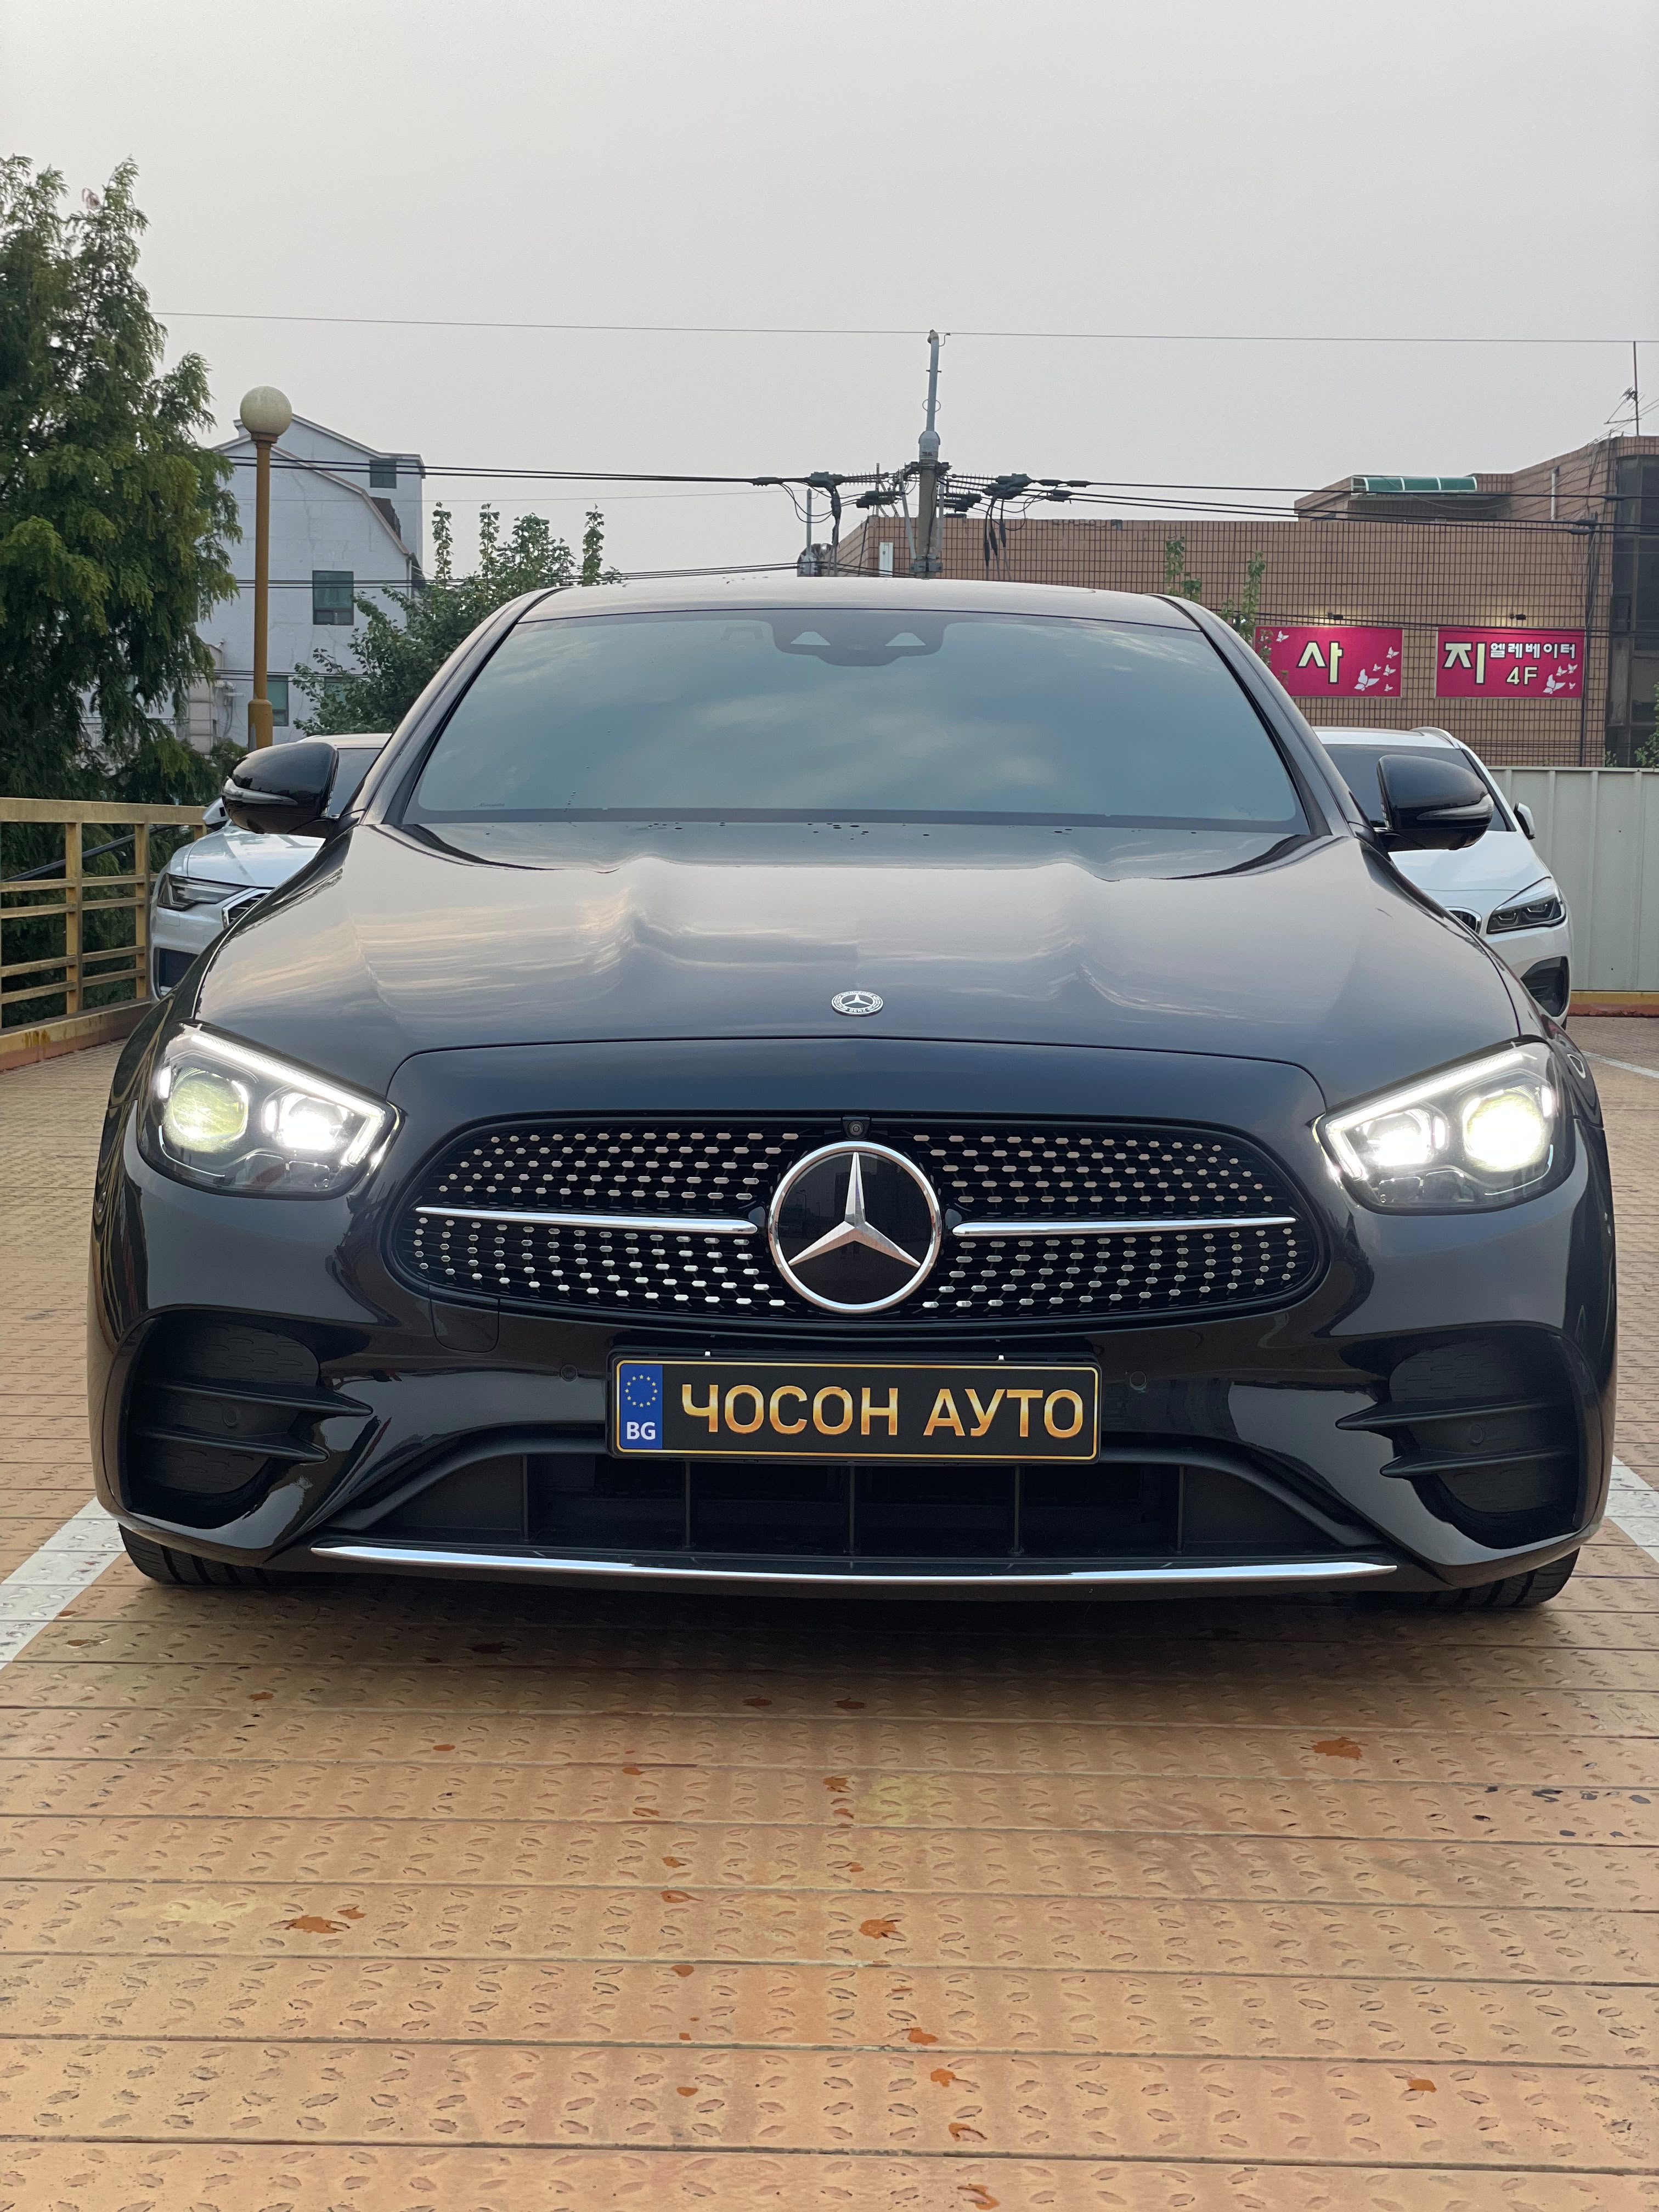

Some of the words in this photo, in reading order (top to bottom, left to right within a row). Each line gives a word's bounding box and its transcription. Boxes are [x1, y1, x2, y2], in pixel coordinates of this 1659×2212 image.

[1296, 640, 1344, 684] 사
[1442, 641, 1486, 685] 지
[1489, 642, 1576, 659] 엘레베이터
[1505, 665, 1538, 686] 4F
[681, 1384, 898, 1436] ЧОСОН
[923, 1388, 1084, 1438] АУТО
[626, 1422, 656, 1441] BG
